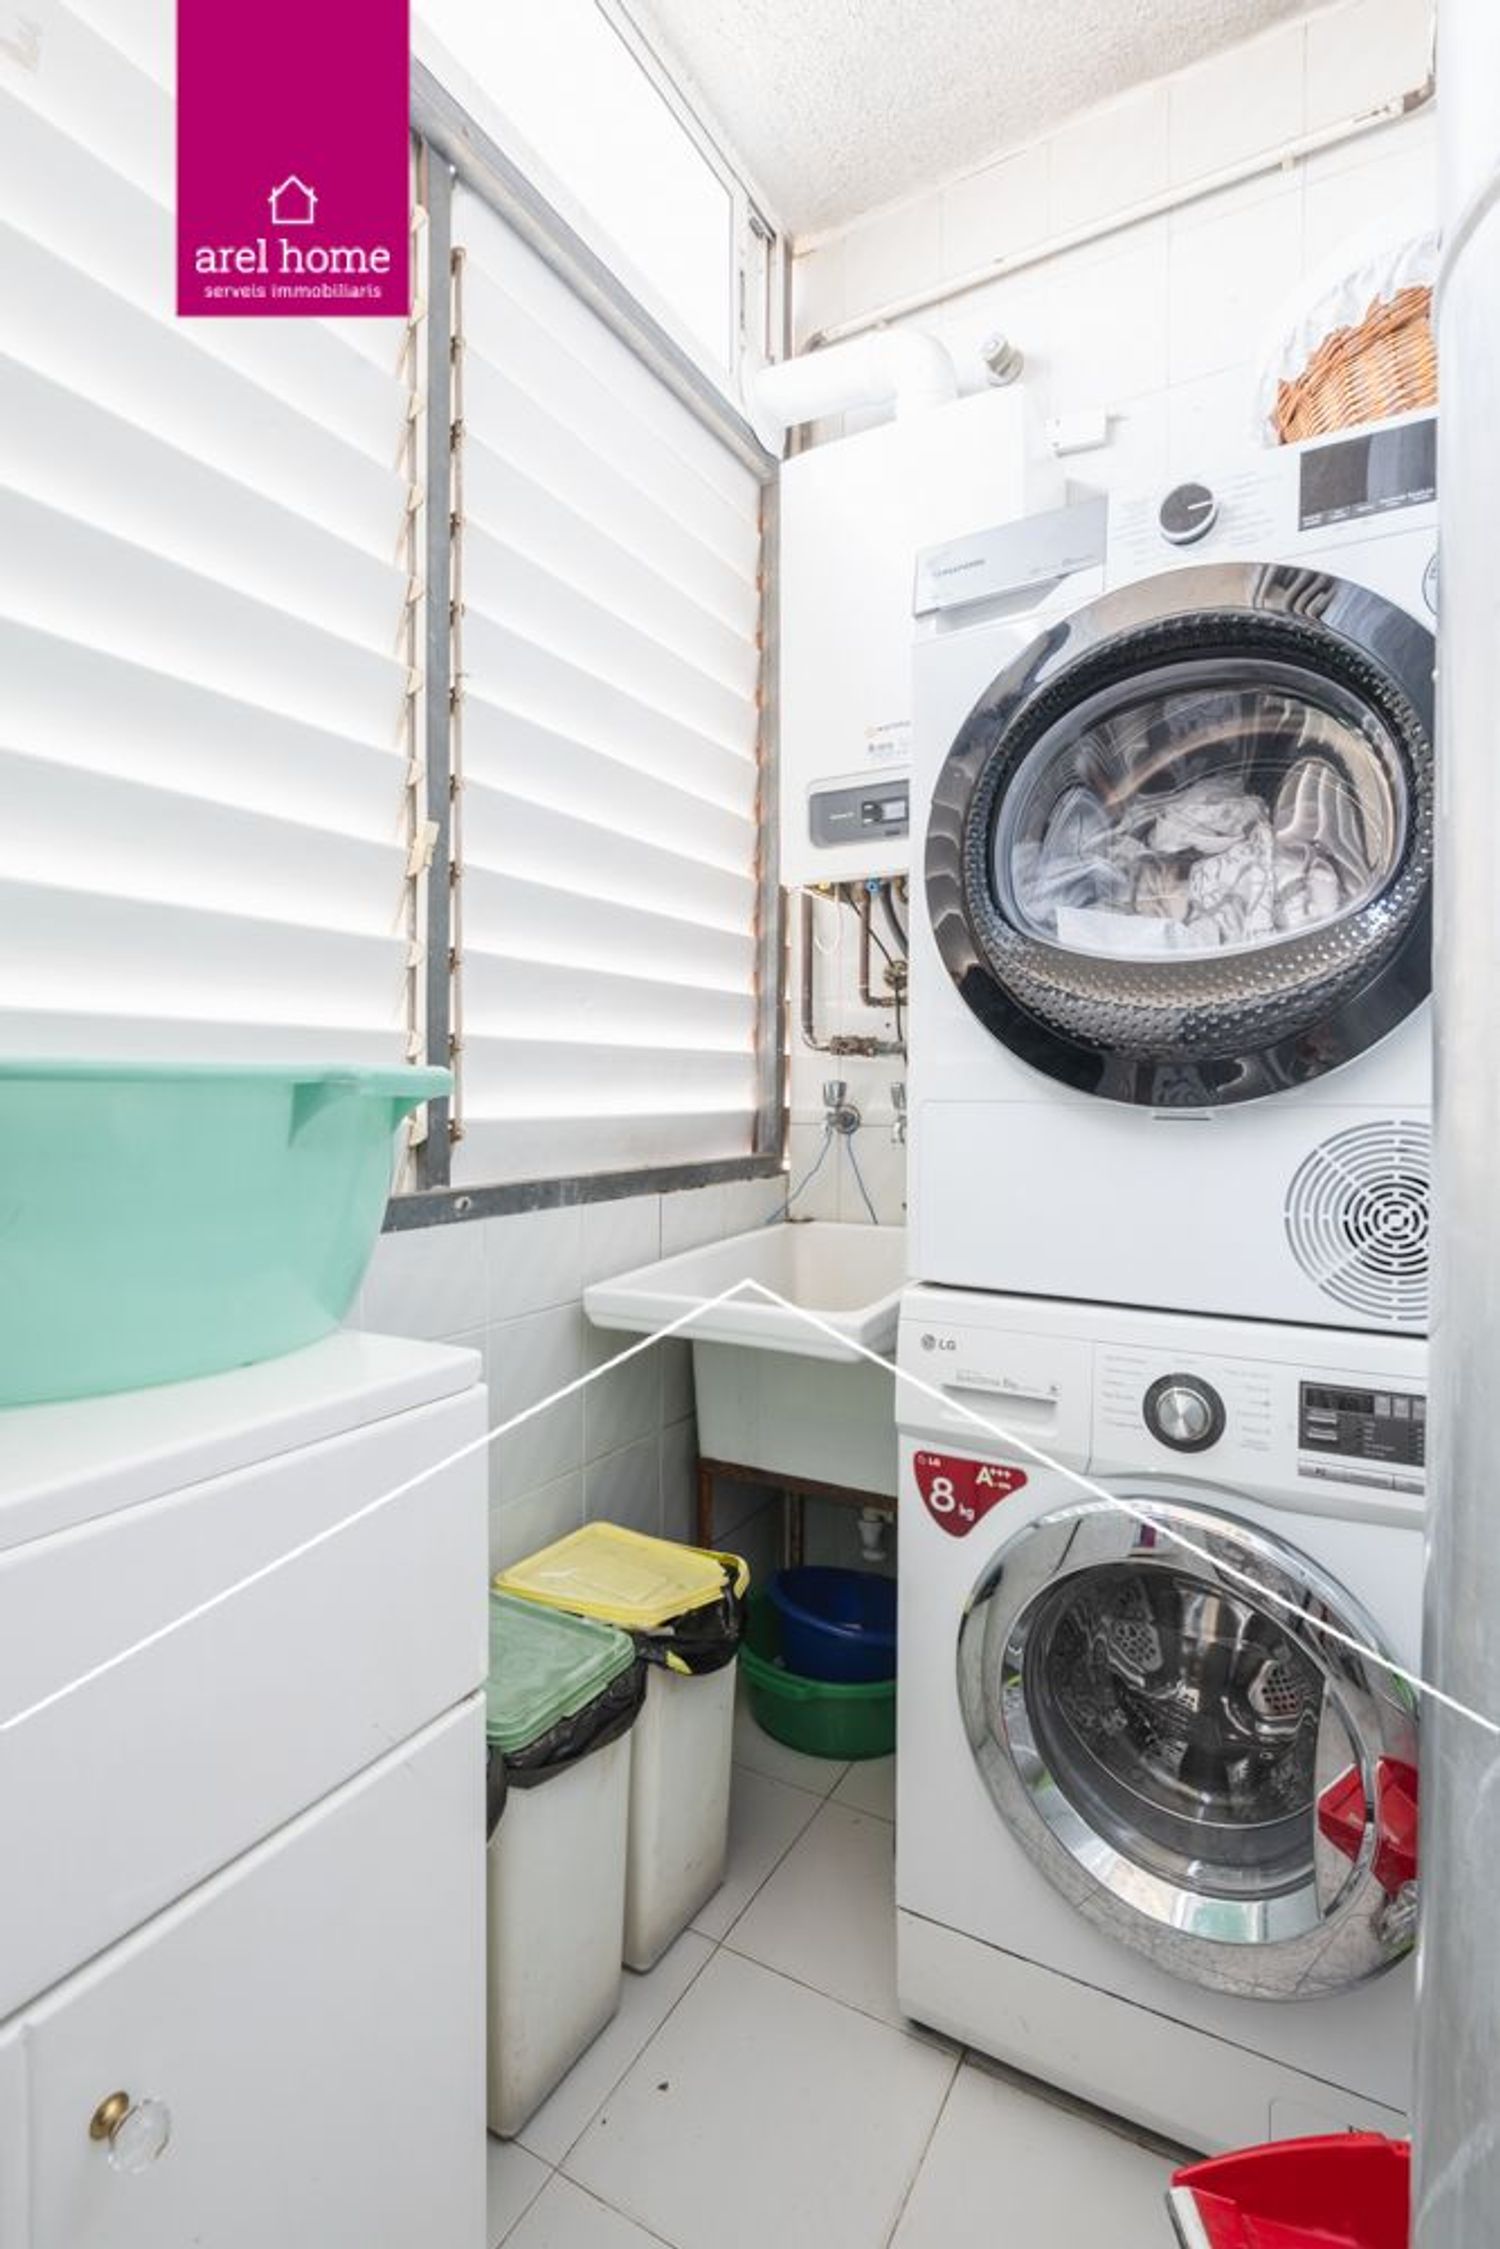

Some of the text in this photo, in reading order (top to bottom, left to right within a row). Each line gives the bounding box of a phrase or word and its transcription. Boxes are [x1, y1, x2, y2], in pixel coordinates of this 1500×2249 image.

[938, 1338, 956, 1351] LG
[928, 1456, 942, 1468] LG
[929, 1476, 956, 1513] 8
[958, 1502, 976, 1522] kg
